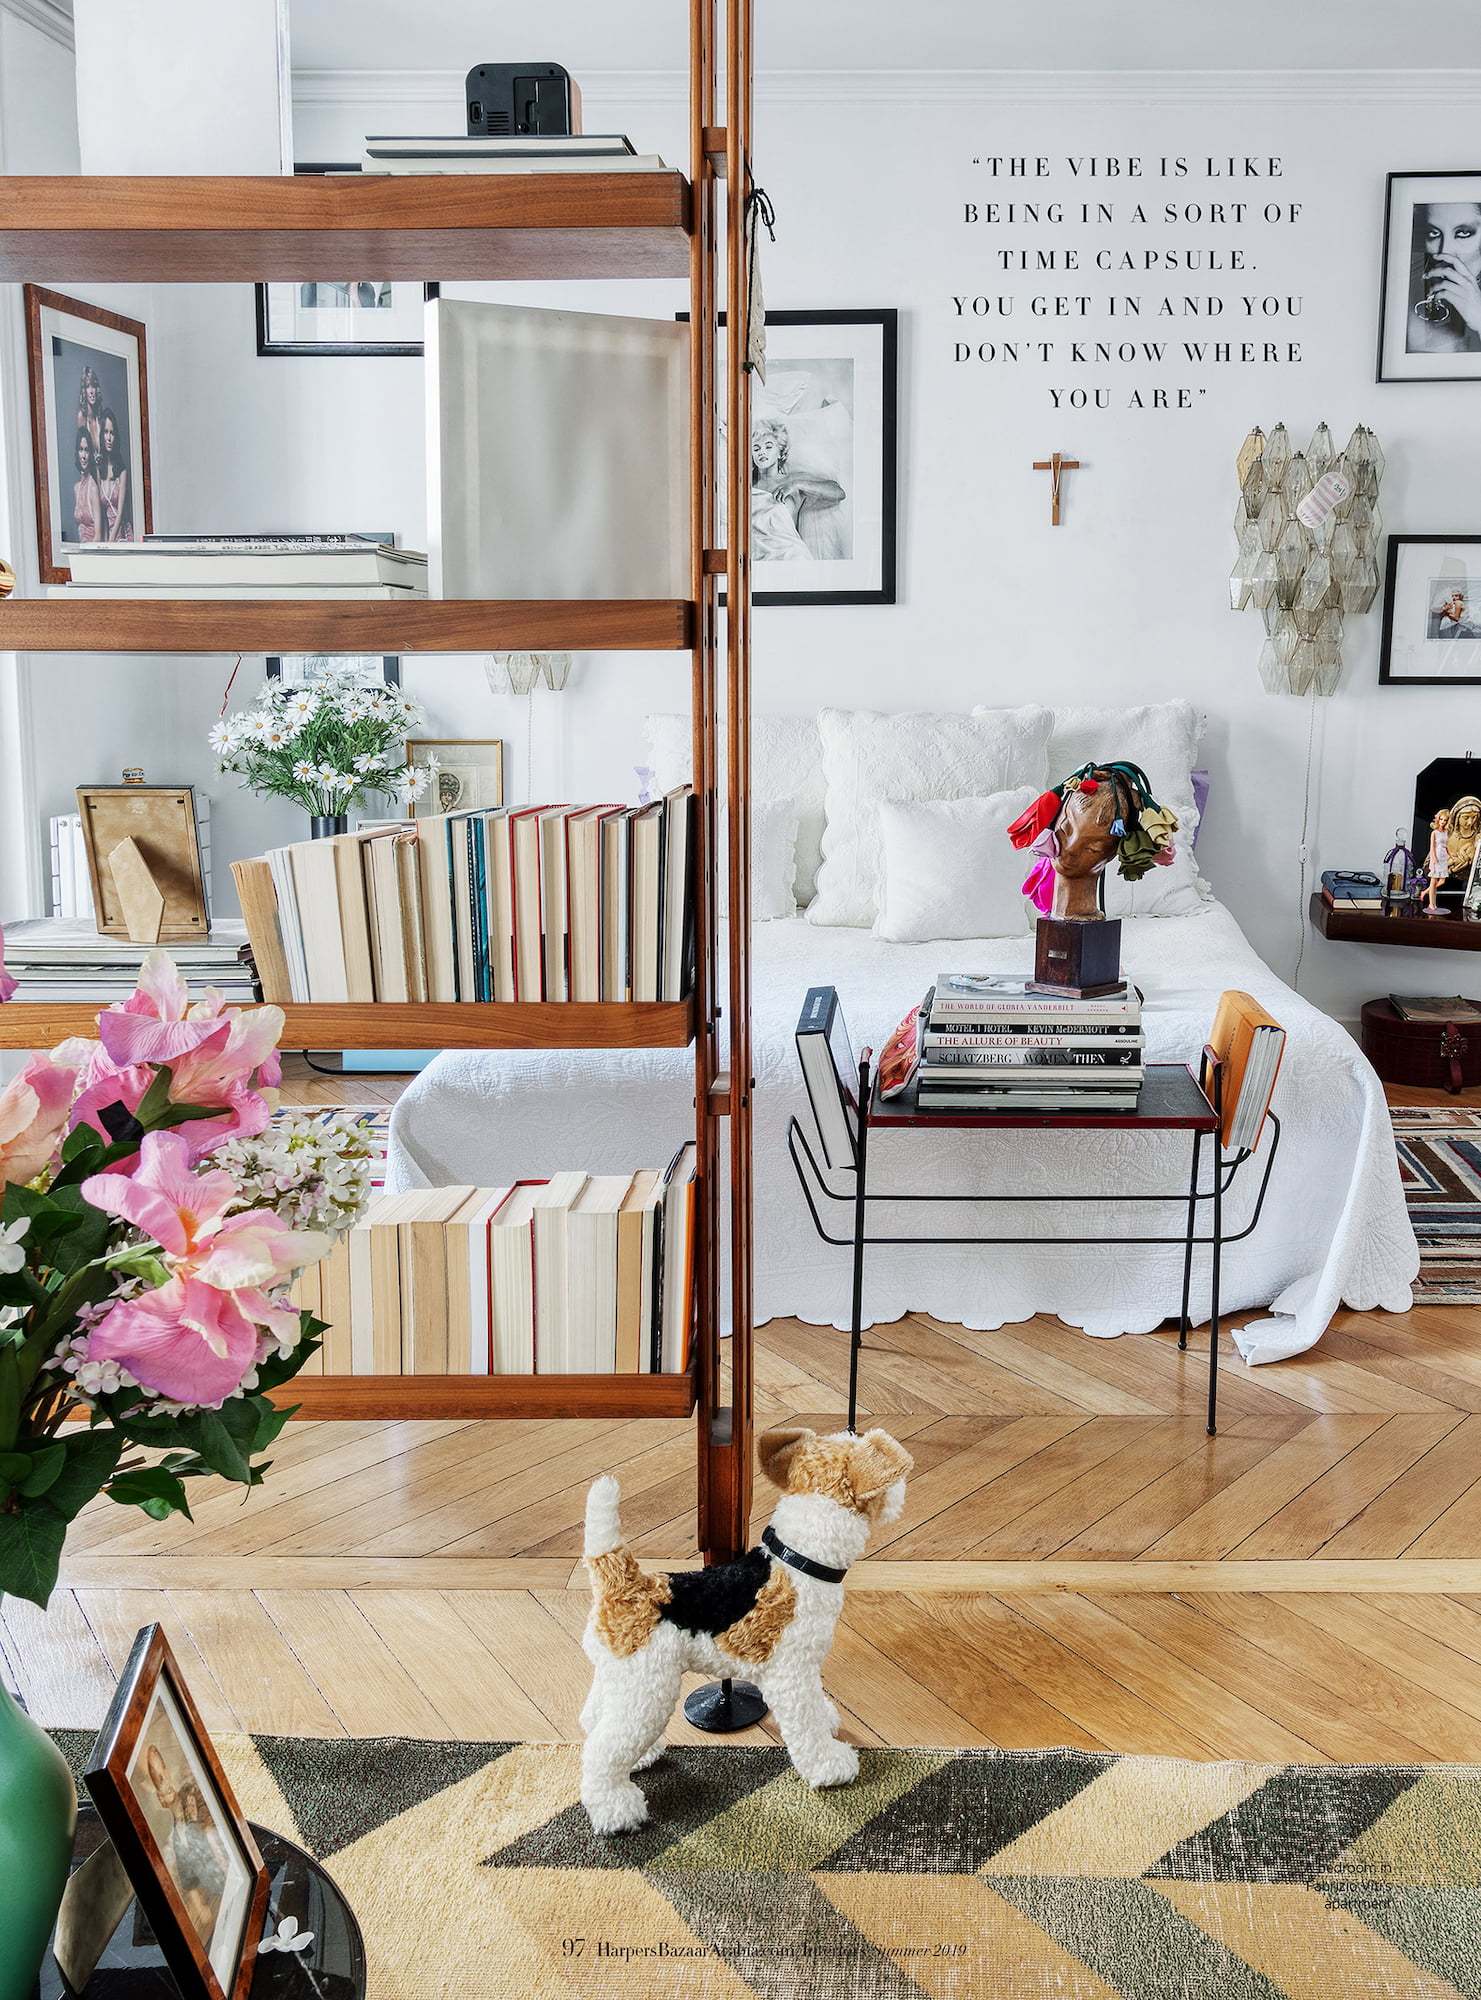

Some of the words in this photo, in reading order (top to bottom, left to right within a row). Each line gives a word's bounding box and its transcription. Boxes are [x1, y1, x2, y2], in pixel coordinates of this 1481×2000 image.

[945, 1024, 975, 1033] MOTEL
[984, 1024, 1013, 1033] HOTEL
[1027, 1025, 1054, 1034] KEVIN
[1055, 1025, 1110, 1034] McDERMOTT
[937, 1037, 959, 1046] THE
[961, 1037, 1002, 1046] ALLURE
[1004, 1037, 1019, 1046] OF
[1021, 1037, 1063, 1046] BEAUTY
[938, 1053, 1012, 1064] SCHATZBERG
[1023, 1054, 1069, 1064] WOMEN
[1072, 1053, 1106, 1064] THEN
